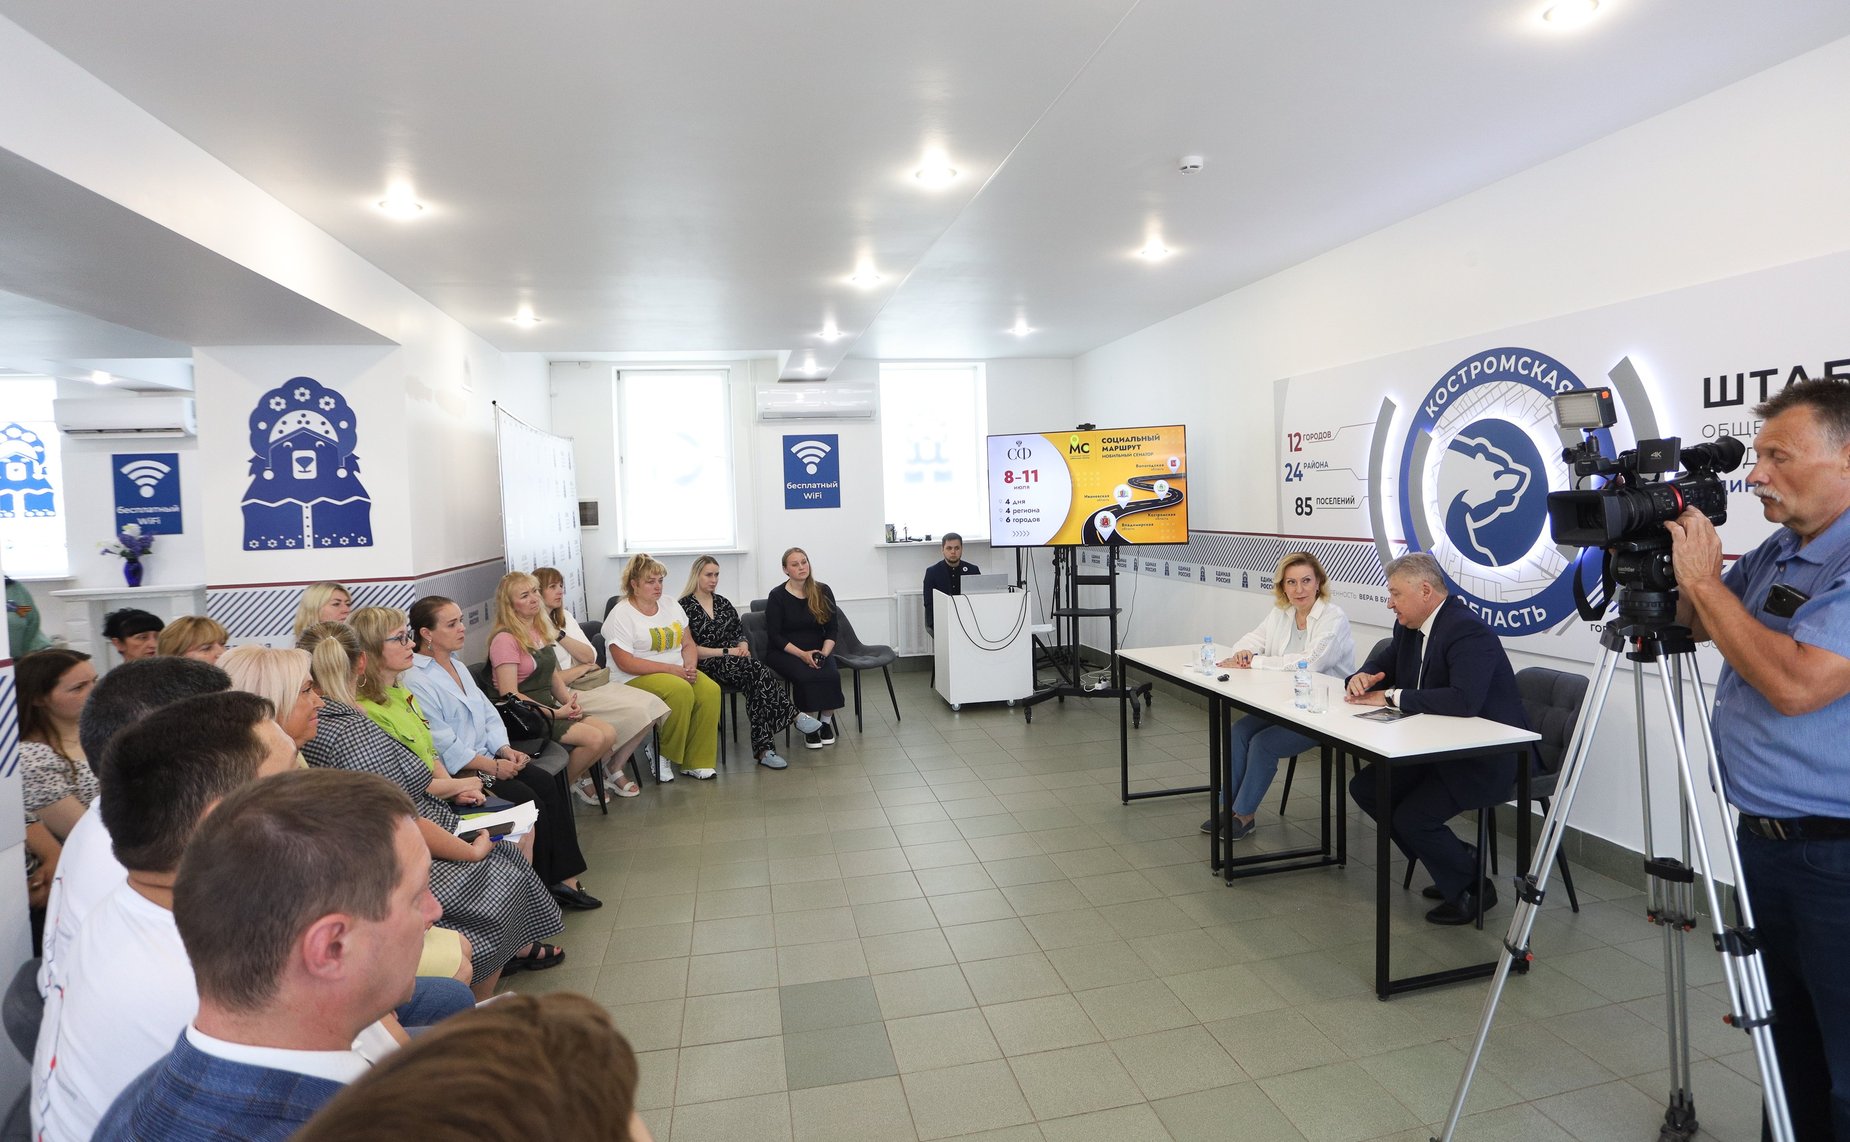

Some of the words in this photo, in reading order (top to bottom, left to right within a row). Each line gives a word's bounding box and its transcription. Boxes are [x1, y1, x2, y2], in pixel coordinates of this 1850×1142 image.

[1425, 354, 1574, 418] КОСТРОМСКАЯ
[1101, 433, 1160, 444] СОЦИАЛЬНЫЙ
[1101, 444, 1141, 452] МАРШРУТ
[1288, 432, 1302, 452] 12
[1303, 431, 1332, 441] ГОРОДОВ
[1284, 462, 1303, 482] 24
[1304, 460, 1328, 469] РАЙОНА
[787, 481, 838, 489] бесплатный
[1295, 497, 1313, 516] 85
[1316, 496, 1355, 505] ПОСЕЛЕНИЙ
